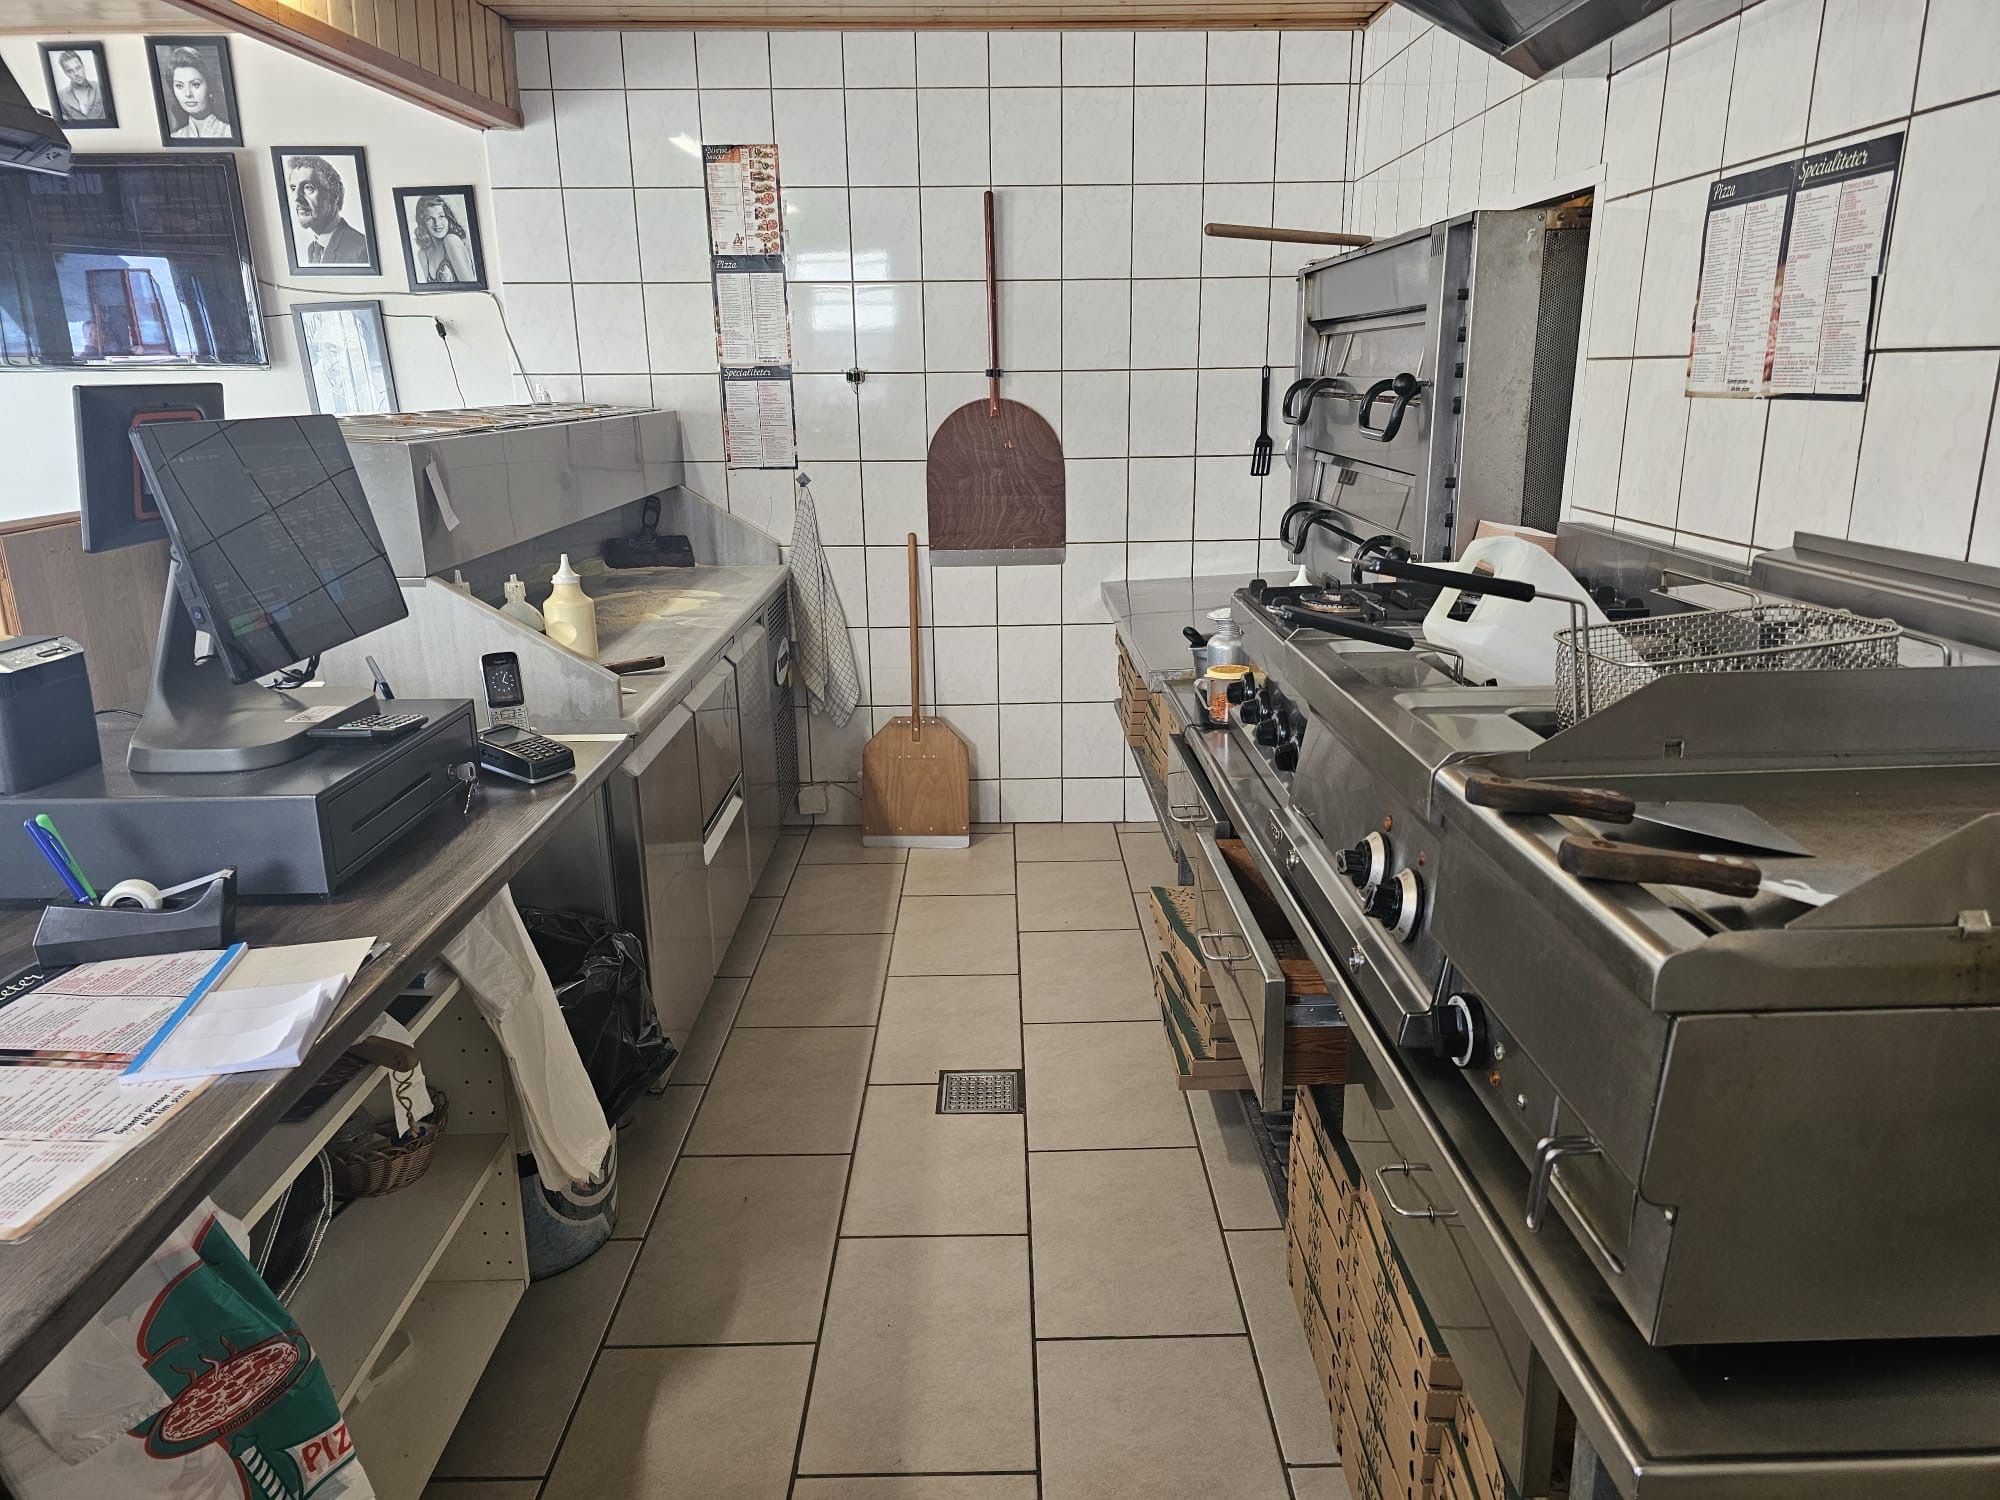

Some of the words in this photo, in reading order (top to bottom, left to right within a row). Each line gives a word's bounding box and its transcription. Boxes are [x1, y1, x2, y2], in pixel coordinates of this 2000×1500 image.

[1798, 149, 1869, 188] Specialiteter
[1712, 182, 1737, 201] Pizza
[715, 259, 738, 270] Pizza
